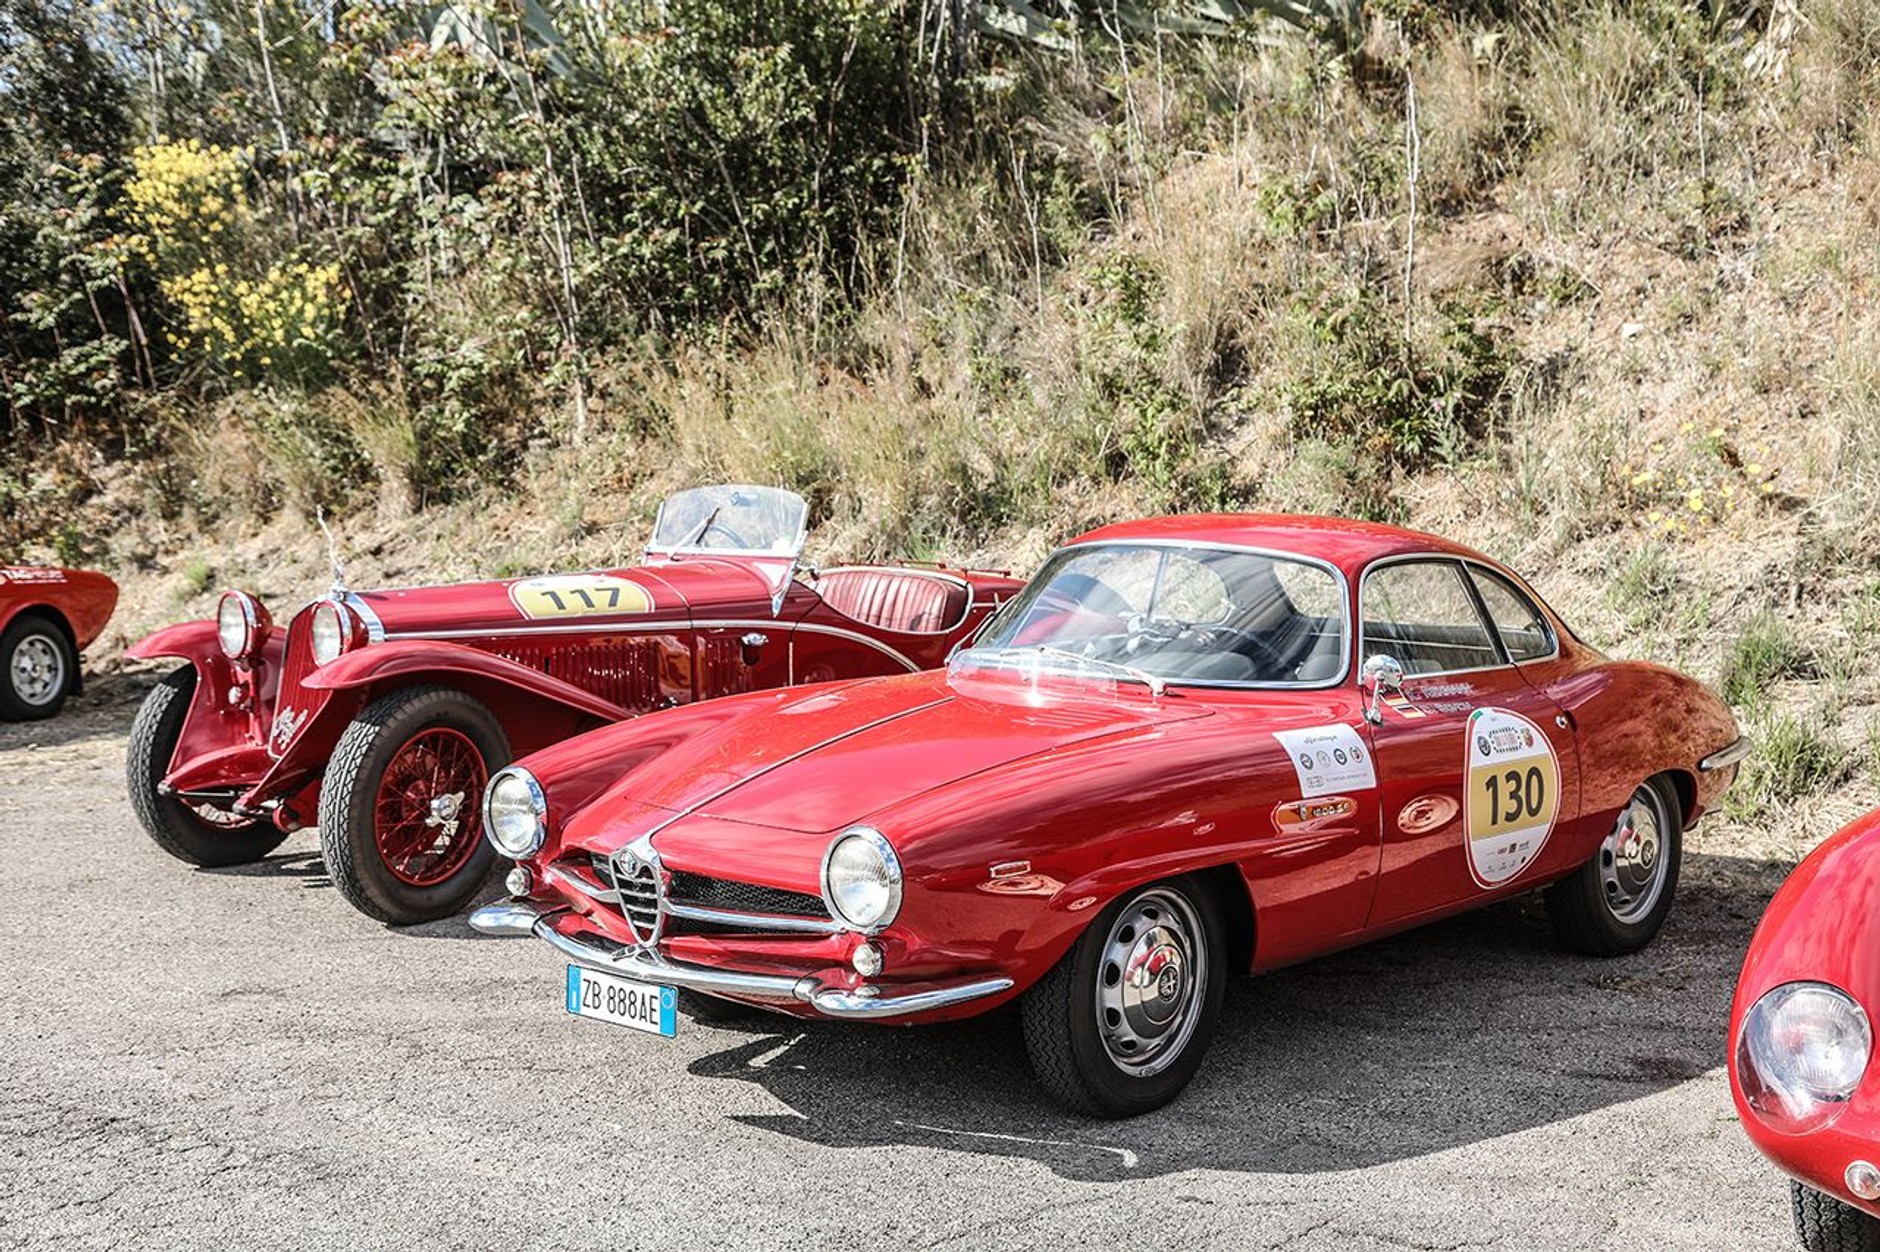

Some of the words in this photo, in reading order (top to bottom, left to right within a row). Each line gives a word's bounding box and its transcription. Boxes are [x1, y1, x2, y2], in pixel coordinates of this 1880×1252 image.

[541, 587, 620, 610] 117
[1485, 766, 1544, 826] 130
[583, 978, 601, 1010] ZB
[607, 985, 659, 1026] 888AE
